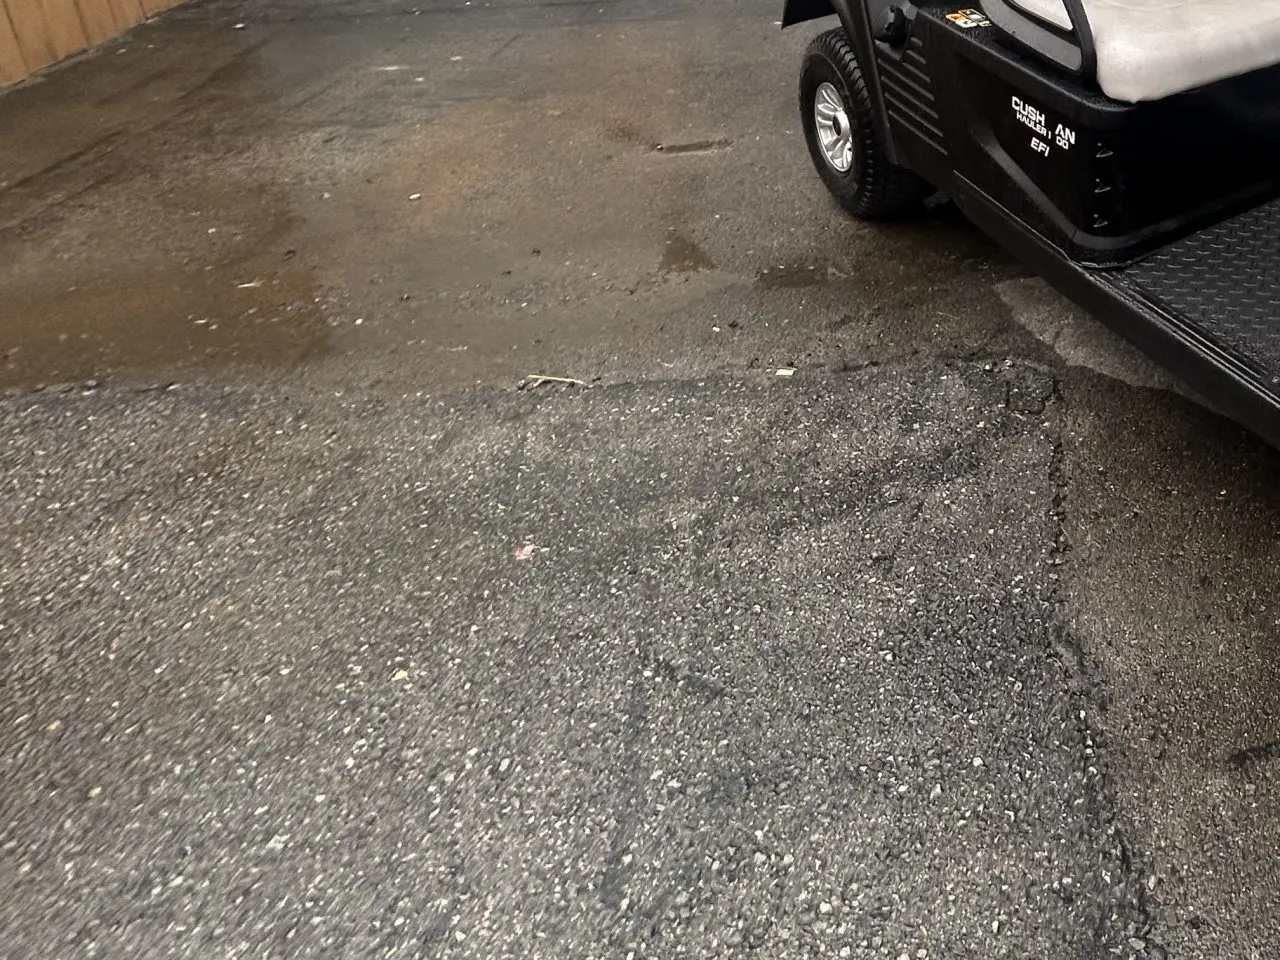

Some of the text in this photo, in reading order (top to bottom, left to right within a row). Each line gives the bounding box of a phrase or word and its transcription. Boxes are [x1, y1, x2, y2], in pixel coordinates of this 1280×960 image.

[1011, 95, 1075, 145] CUSHAN
[1016, 110, 1069, 150] HAULER 100
[1030, 136, 1050, 157] EFI
